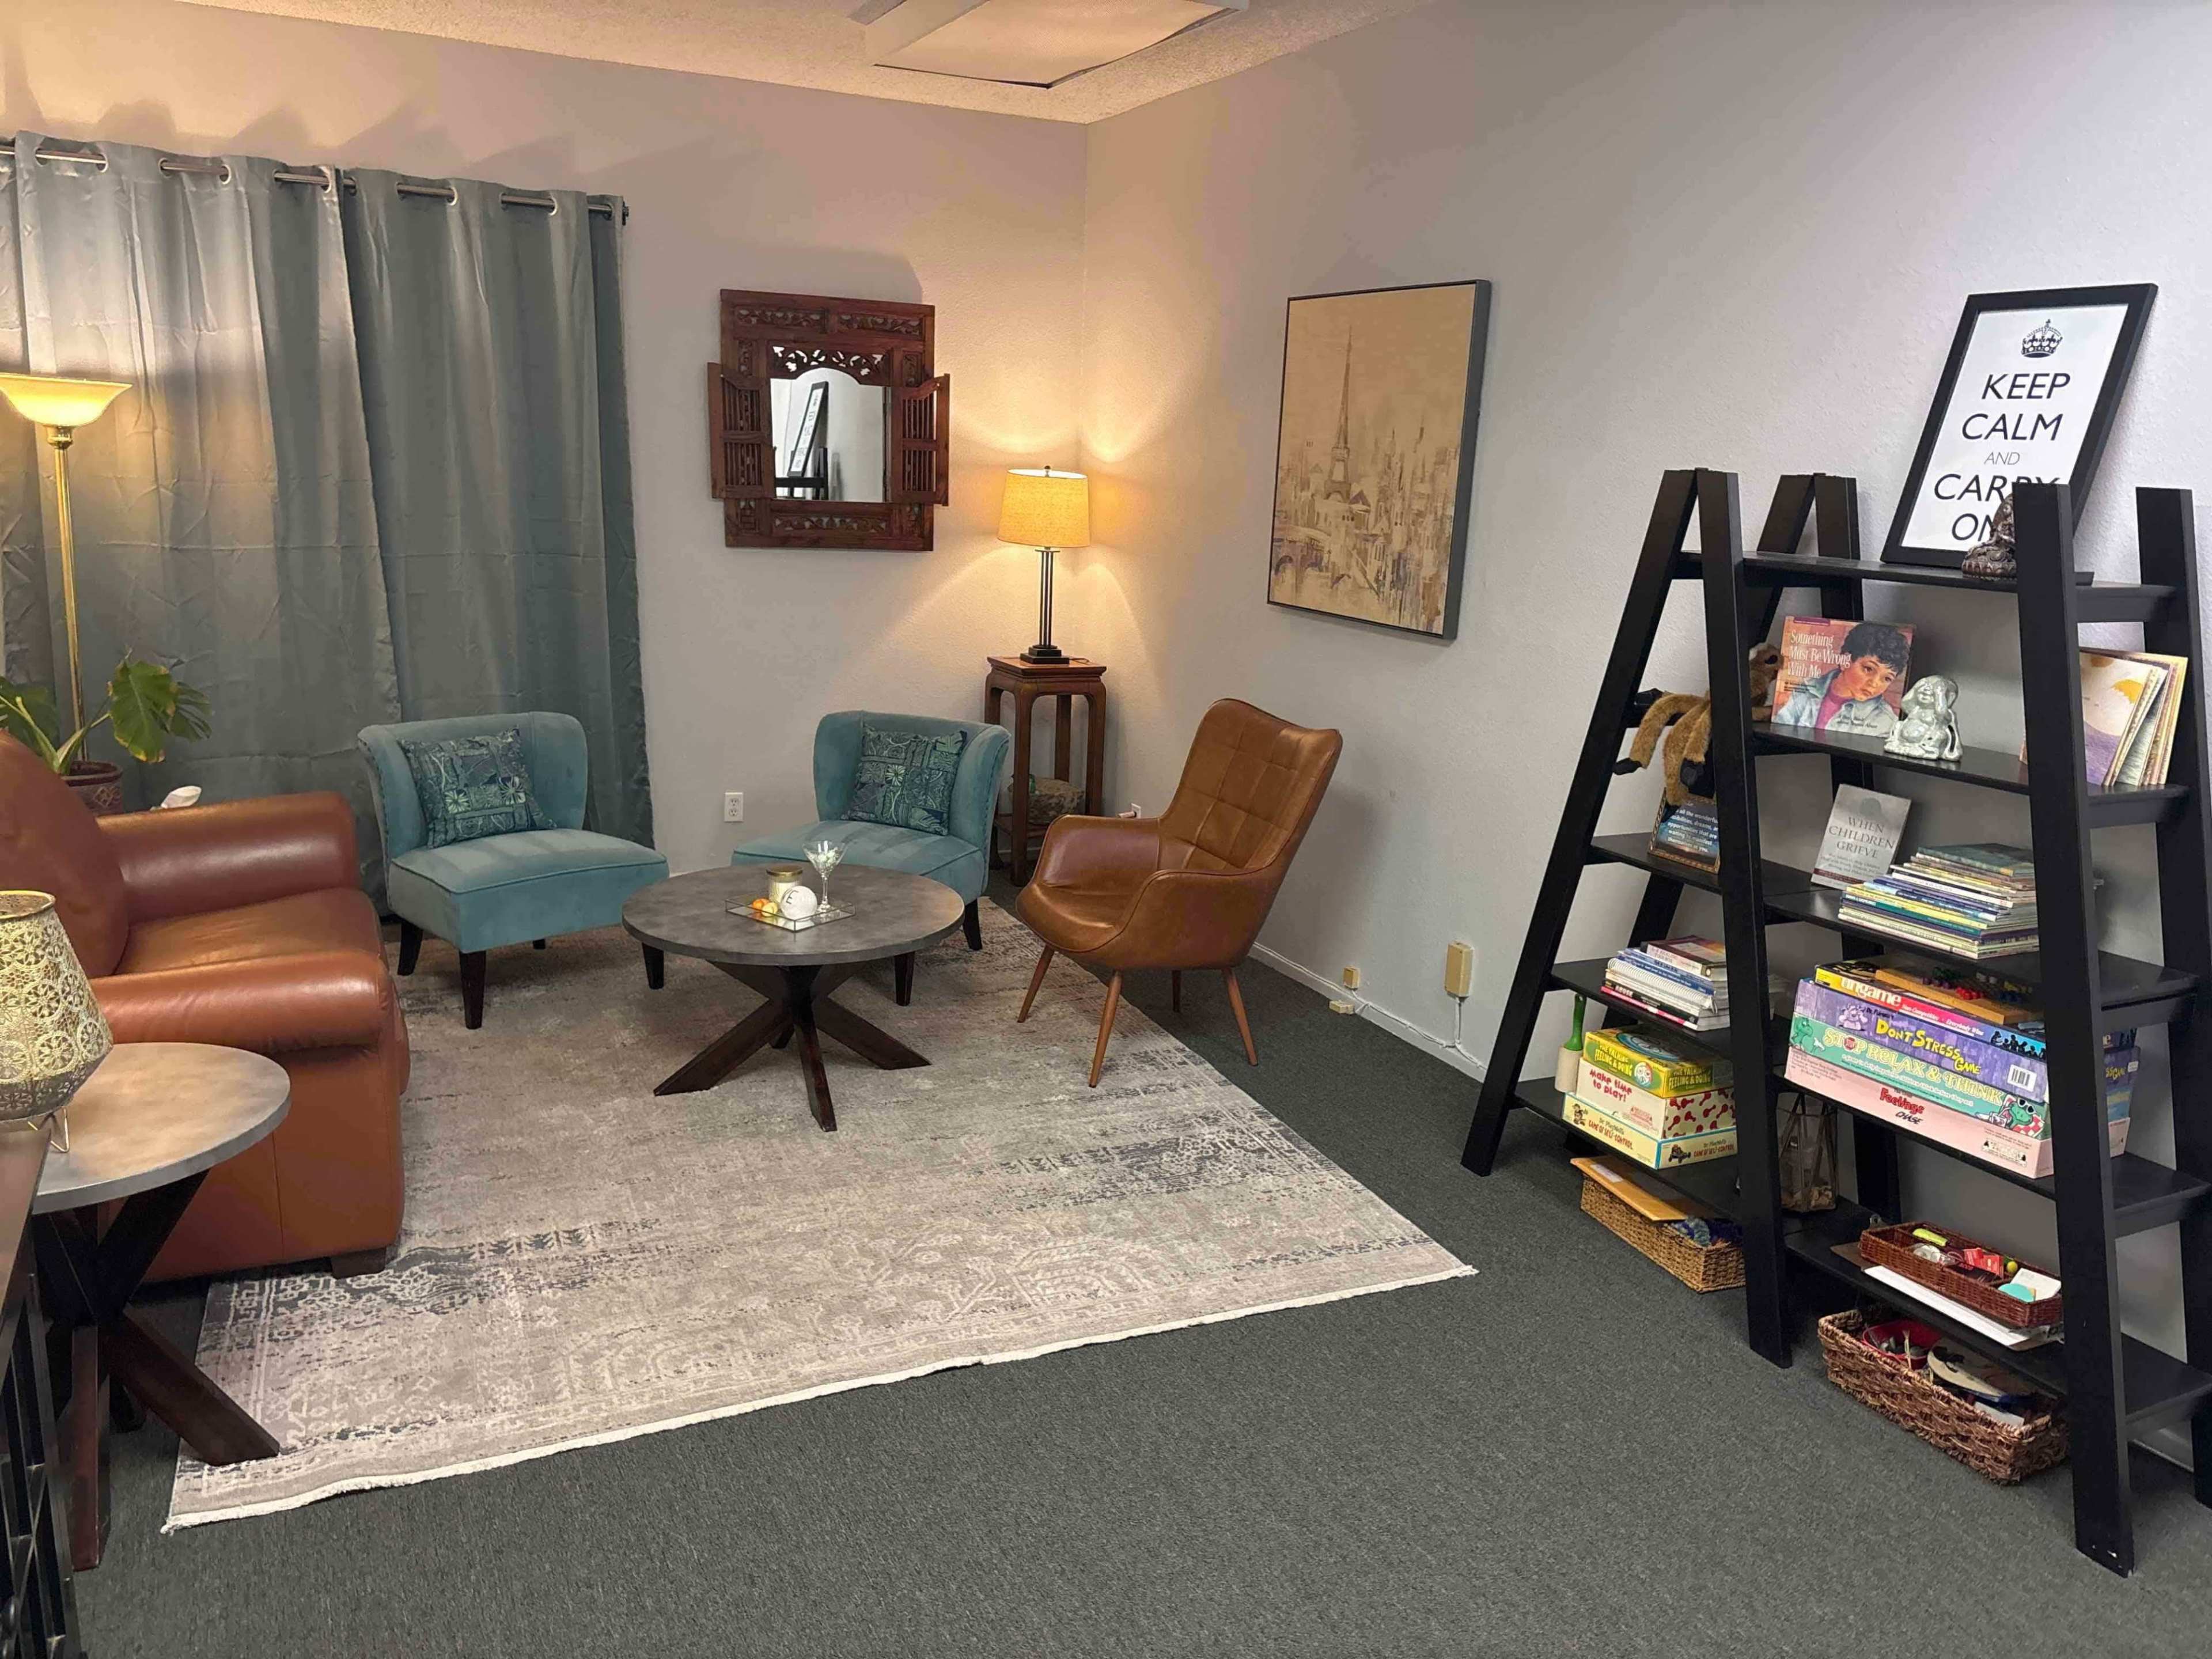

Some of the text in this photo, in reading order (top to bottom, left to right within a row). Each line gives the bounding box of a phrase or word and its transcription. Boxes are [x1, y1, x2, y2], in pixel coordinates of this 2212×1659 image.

[1982, 373, 2070, 399] KEEP
[1962, 414, 2063, 441] CALM
[1984, 452, 2020, 465] AND
[1934, 474, 2060, 502] CAR
[1790, 630, 1834, 650] Something
[1789, 646, 1852, 669] Must Be Wrong
[1787, 661, 1821, 679] With Me
[1848, 817, 1884, 833] WHEN
[1829, 826, 1895, 849] CHILDREN
[1836, 841, 1878, 858] GRIEVE
[1842, 976, 1902, 1006] ungame
[1912, 1029, 1962, 1060] STRESS
[1823, 1028, 1868, 1055] STOP
[1926, 1066, 1942, 1083] &
[1942, 1071, 2005, 1107] THINK
[1954, 1058, 1982, 1074] GAME
[1593, 1080, 1601, 1089] to
[1880, 1088, 1925, 1115] Feelings
[1895, 1112, 1923, 1124] CHASE
